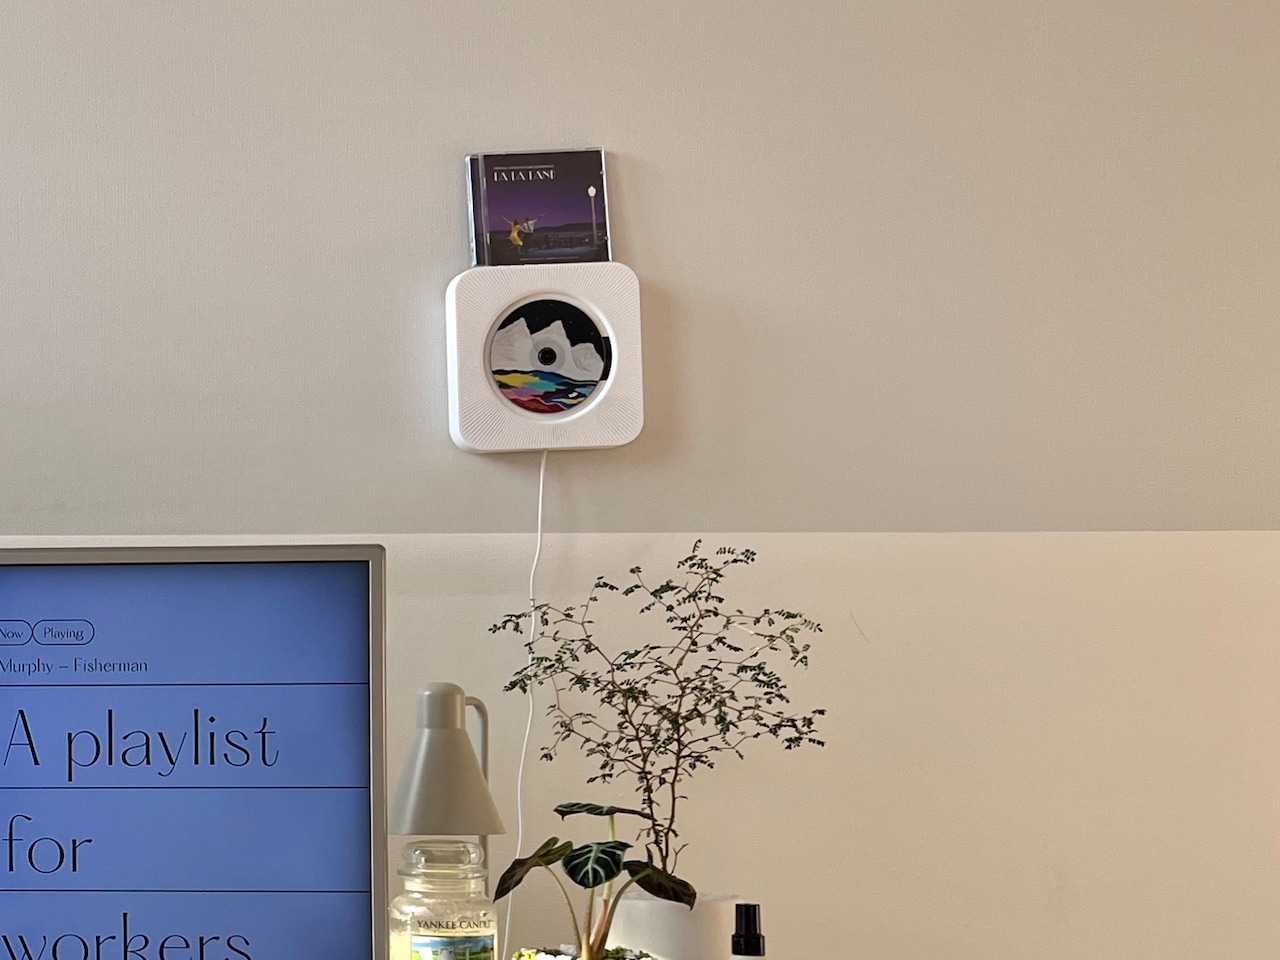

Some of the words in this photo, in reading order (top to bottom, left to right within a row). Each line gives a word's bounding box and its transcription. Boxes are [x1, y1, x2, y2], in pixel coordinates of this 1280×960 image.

[43, 626, 85, 642] Playing
[73, 657, 149, 673] Fisherman
[3, 708, 40, 767] A
[66, 708, 280, 783] playlist
[2, 814, 93, 874] for
[417, 919, 458, 930] YANKEE
